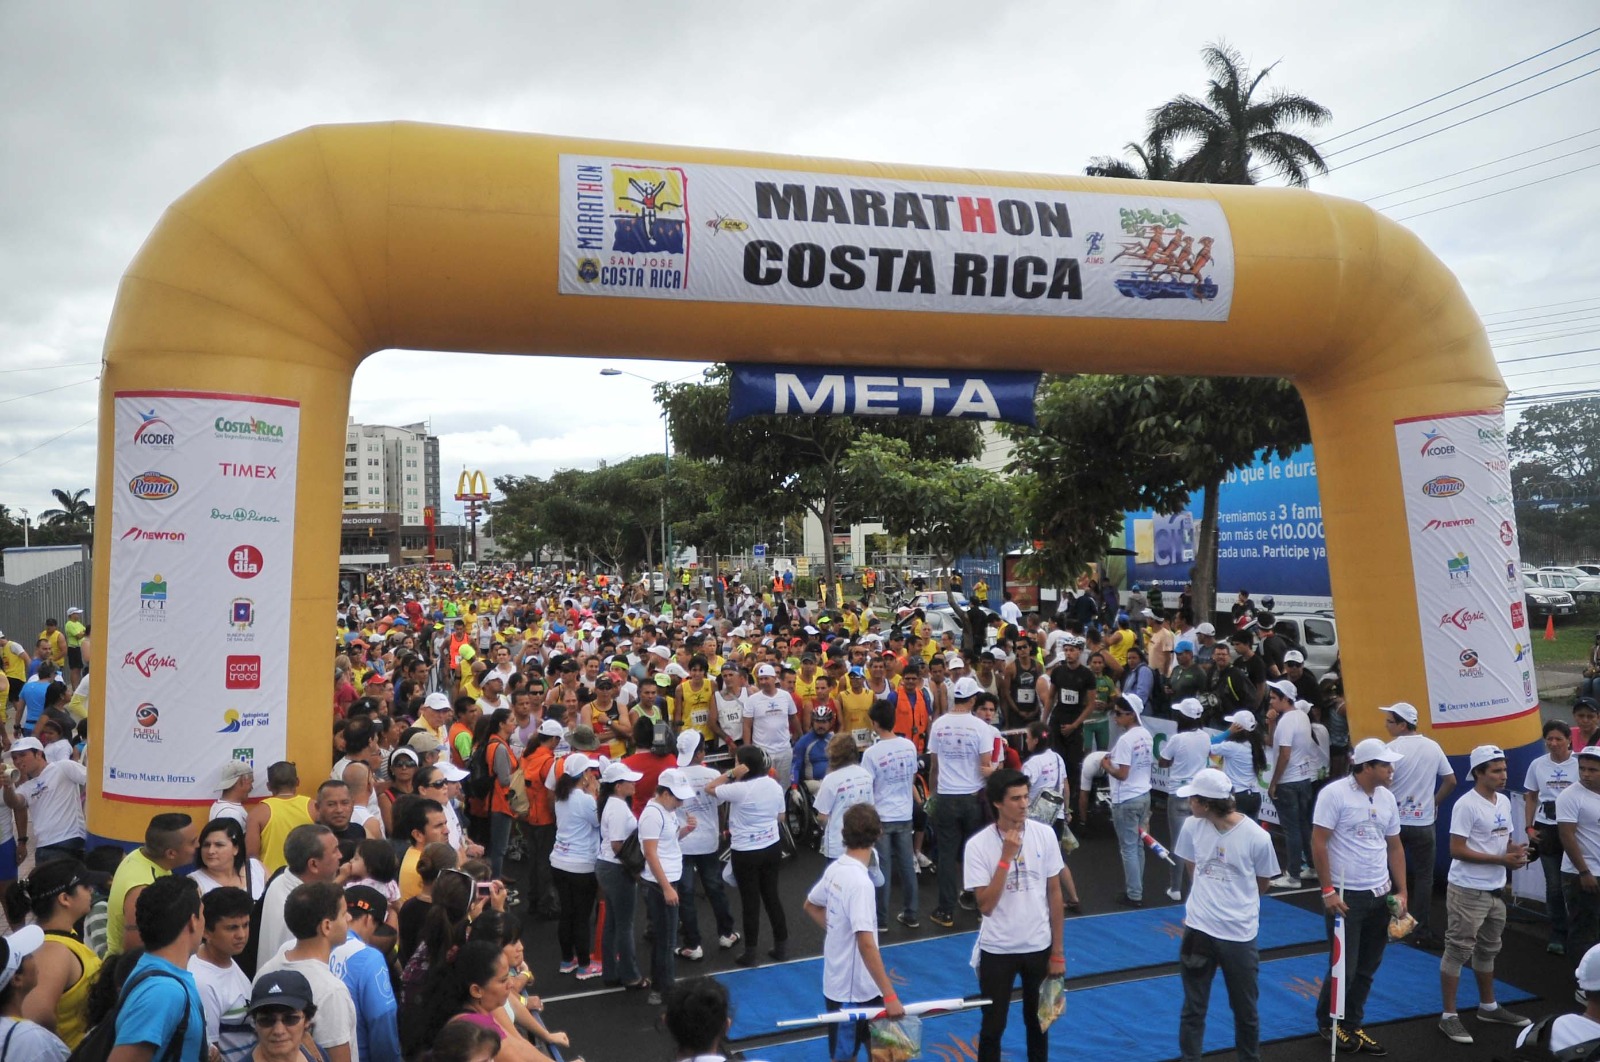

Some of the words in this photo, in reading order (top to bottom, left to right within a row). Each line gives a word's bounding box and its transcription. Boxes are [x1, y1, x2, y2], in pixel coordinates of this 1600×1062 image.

[577, 165, 604, 250] MARATHON
[755, 181, 1073, 238] MARATHON
[610, 256, 634, 265] SAN
[643, 258, 673, 268] JOSE
[1084, 257, 1105, 265] AIMS
[743, 239, 937, 295] COSTA
[952, 252, 1083, 300] RICA
[601, 266, 644, 287] COSTA
[650, 268, 681, 289] RICA
[774, 373, 1001, 419] META
[140, 434, 174, 445] ICODER
[1427, 446, 1456, 456] ICODER
[219, 463, 277, 479] TIMEX
[1241, 466, 1265, 486] que
[1268, 462, 1282, 480] le
[133, 478, 173, 495] Roma
[1428, 482, 1461, 495] Roma
[209, 508, 233, 520] Dos
[1270, 511, 1276, 521] a
[1279, 504, 1288, 521] 3
[1234, 528, 1254, 540] más
[1256, 528, 1268, 539] de
[234, 548, 248, 561] al
[1262, 545, 1310, 561] Participe
[141, 600, 166, 609] ICT
[229, 662, 258, 672] canal
[229, 672, 258, 681] trece
[241, 718, 254, 727] del
[256, 717, 269, 727] Sol
[117, 770, 138, 781] GRUPO
[139, 772, 165, 783] MARTA
[167, 774, 196, 784] HOTELS
